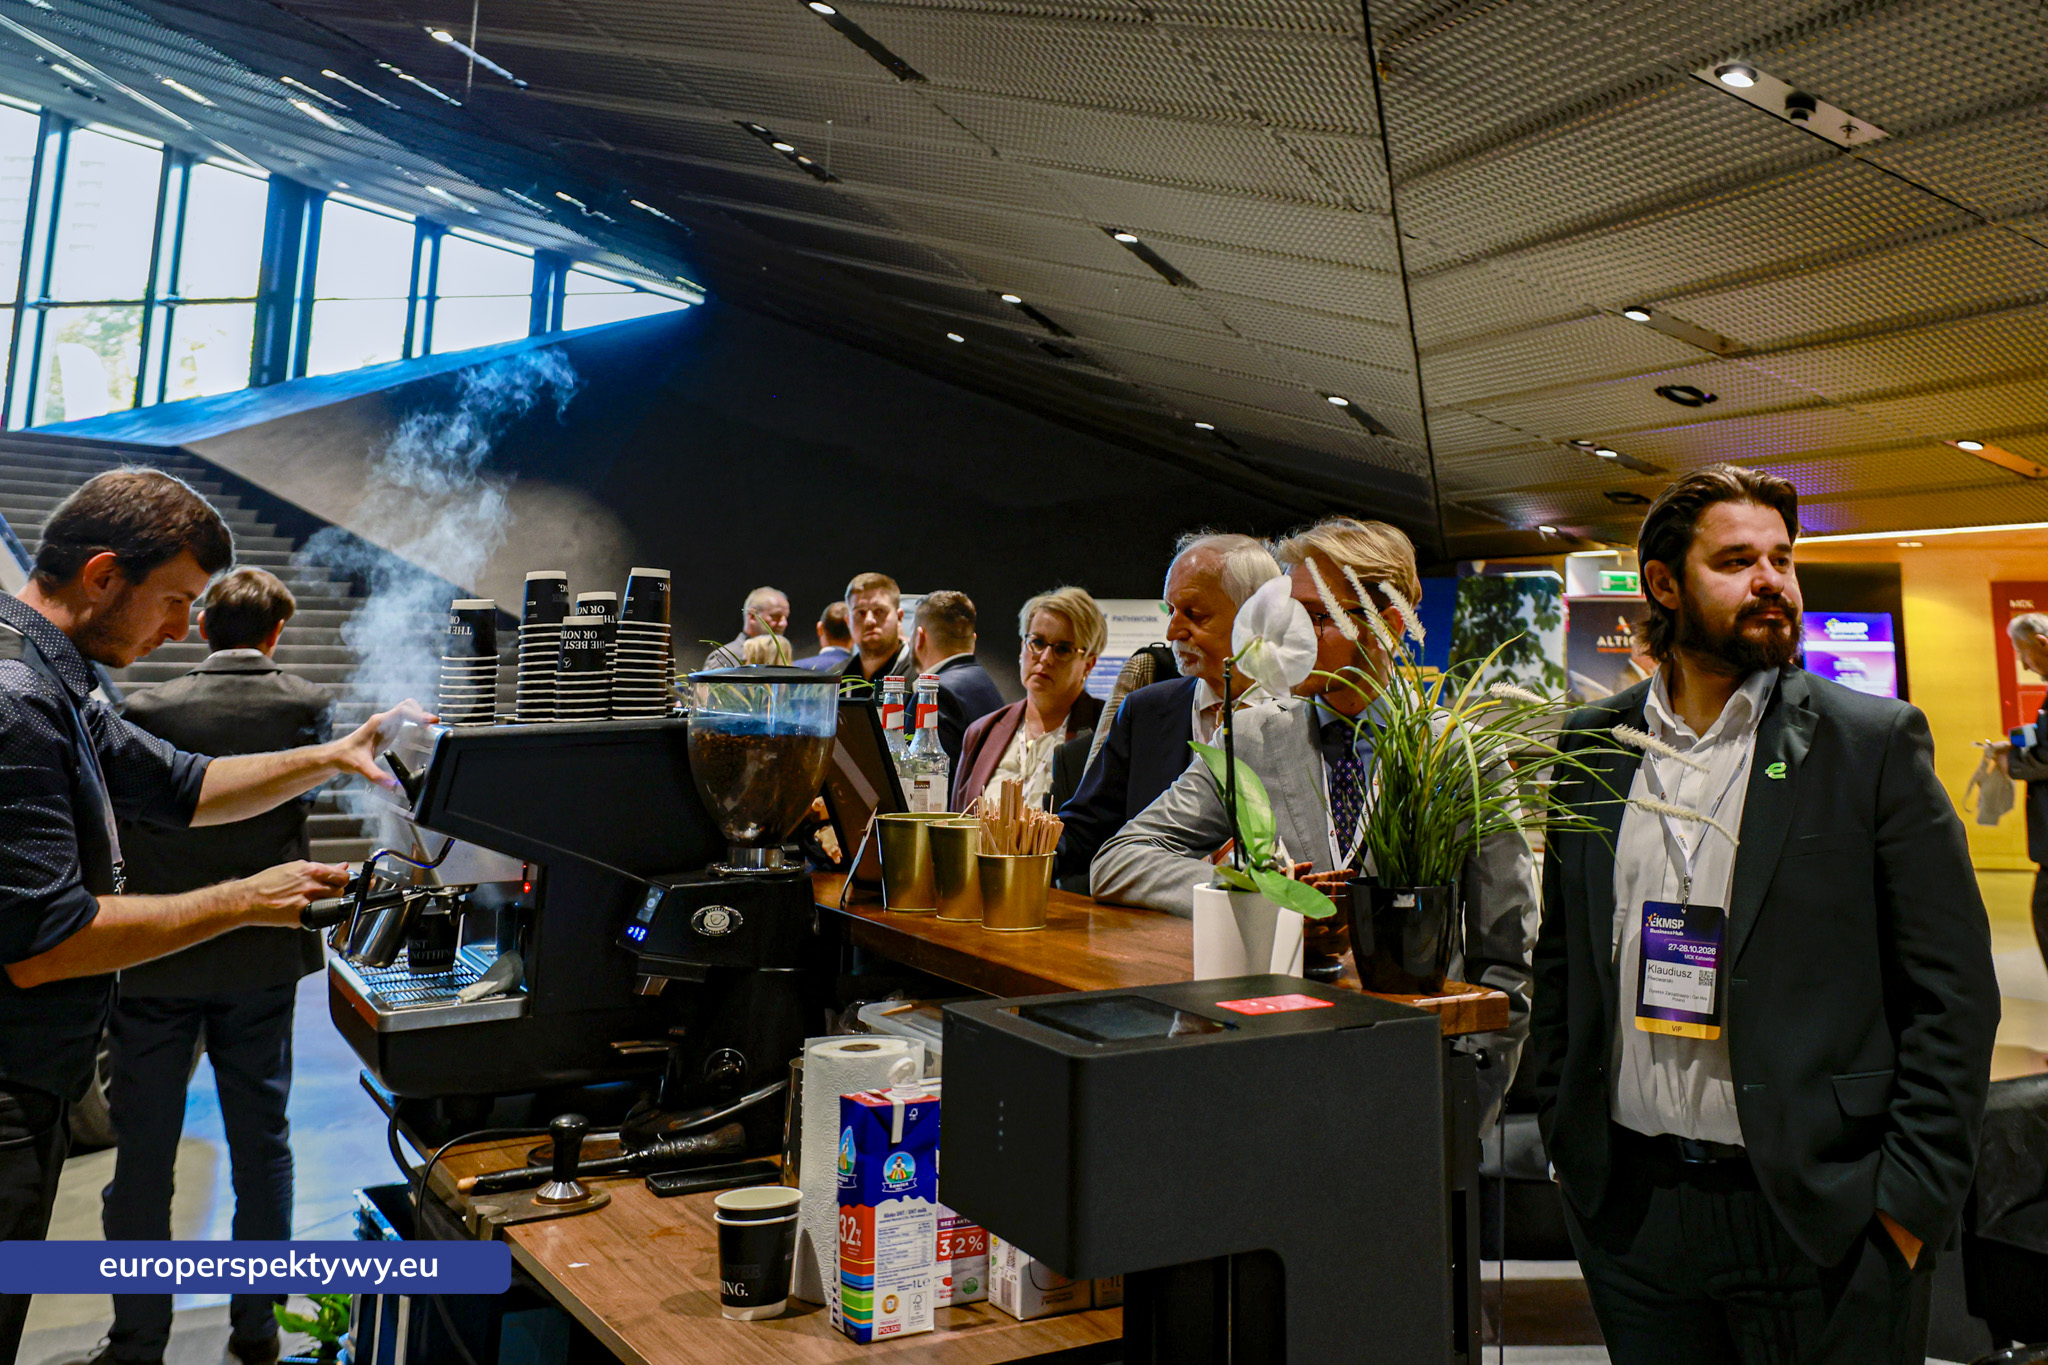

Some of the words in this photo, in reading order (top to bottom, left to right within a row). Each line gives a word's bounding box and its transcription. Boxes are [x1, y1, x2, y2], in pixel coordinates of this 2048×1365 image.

[604, 615, 616, 624] TH
[583, 630, 598, 640] OR
[564, 640, 588, 650] BEST
[1648, 964, 1692, 978] Klaudiusz
[879, 1324, 901, 1334] POLSKI
